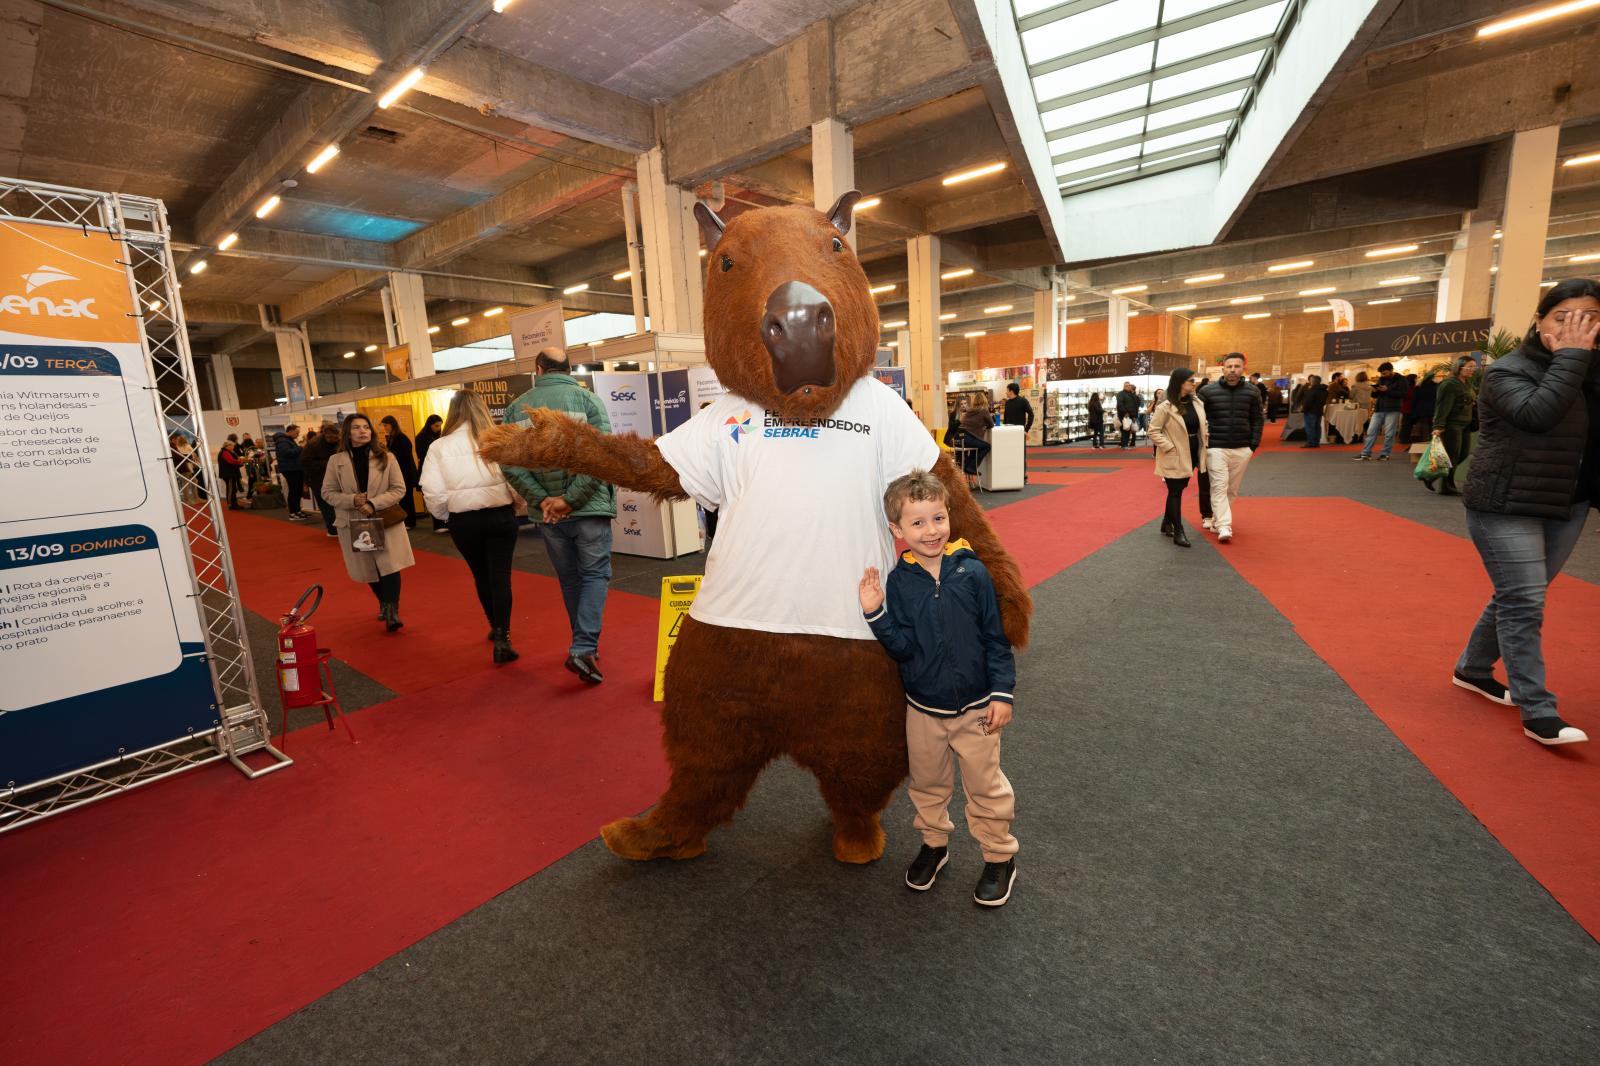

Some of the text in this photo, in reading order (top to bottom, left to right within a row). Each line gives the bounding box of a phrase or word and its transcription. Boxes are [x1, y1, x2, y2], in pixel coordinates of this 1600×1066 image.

[0, 353, 97, 371] /09 TERÇA
[1073, 354, 1121, 367] UNIQUE
[474, 381, 507, 393] AQUI NO
[16, 391, 90, 399] Witmarsum
[611, 391, 636, 401] Sesc
[18, 402, 88, 410] holandesas
[4, 412, 71, 422] de Queijos
[30, 427, 47, 435] do
[763, 428, 820, 439] SEBRAE
[11, 437, 82, 447] cheesecake
[84, 435, 100, 443] de
[16, 449, 45, 457] com
[47, 447, 80, 455] calda
[82, 445, 97, 453] de
[13, 460, 31, 468] de
[32, 457, 92, 467] Carlópolis
[622, 503, 638, 512] Sesc
[5, 535, 147, 562] 13/09 DOMINGO
[13, 581, 42, 591] Rota
[44, 578, 60, 586] da
[62, 572, 104, 584] cerveja
[37, 584, 92, 598] regionais
[103, 580, 111, 588] a
[50, 593, 88, 606] alemã
[21, 611, 70, 626] Comida
[71, 607, 95, 617] que
[96, 599, 135, 613] acolhe:
[78, 607, 143, 627] paranaense
[15, 636, 49, 650] prato
